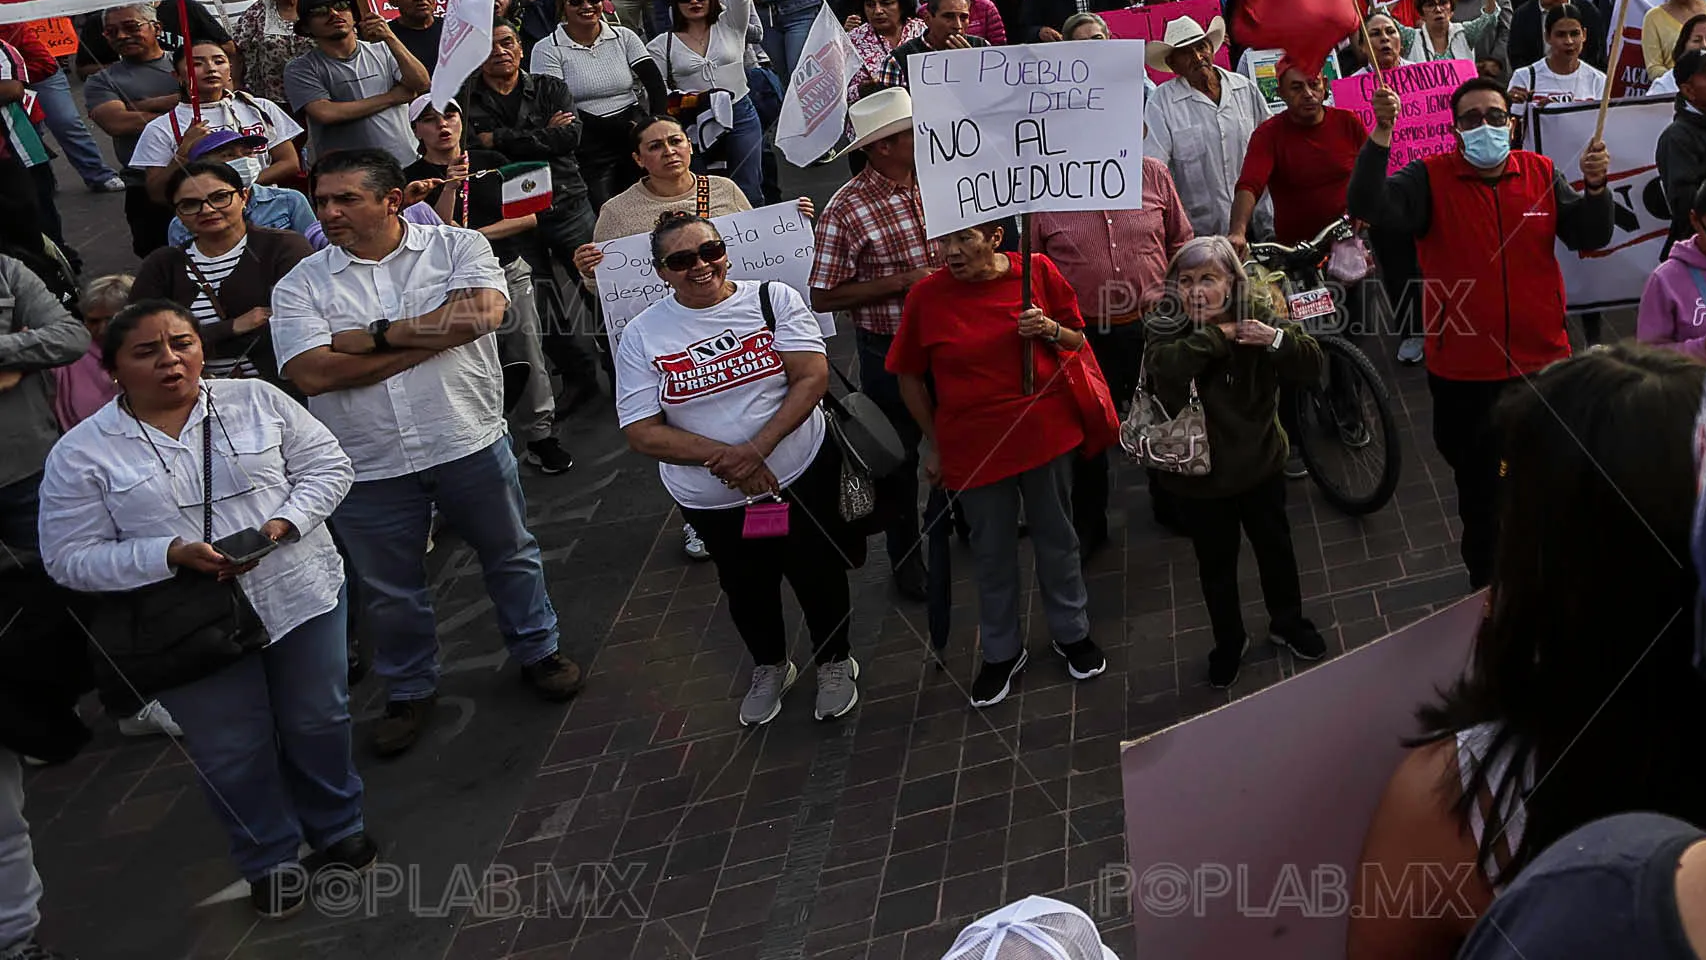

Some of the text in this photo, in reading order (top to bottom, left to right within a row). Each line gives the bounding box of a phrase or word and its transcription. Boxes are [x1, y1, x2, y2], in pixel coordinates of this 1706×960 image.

[920, 50, 1090, 88] EL PUEBLO
[1028, 87, 1105, 115] DICE
[1014, 119, 1067, 158] AL
[773, 208, 807, 235] del
[742, 250, 786, 272] hubo
[691, 336, 739, 362] NO
[755, 337, 772, 348] AL
[669, 351, 757, 384] ACUEDUCTO
[674, 356, 776, 395] PRESA SOLIS
